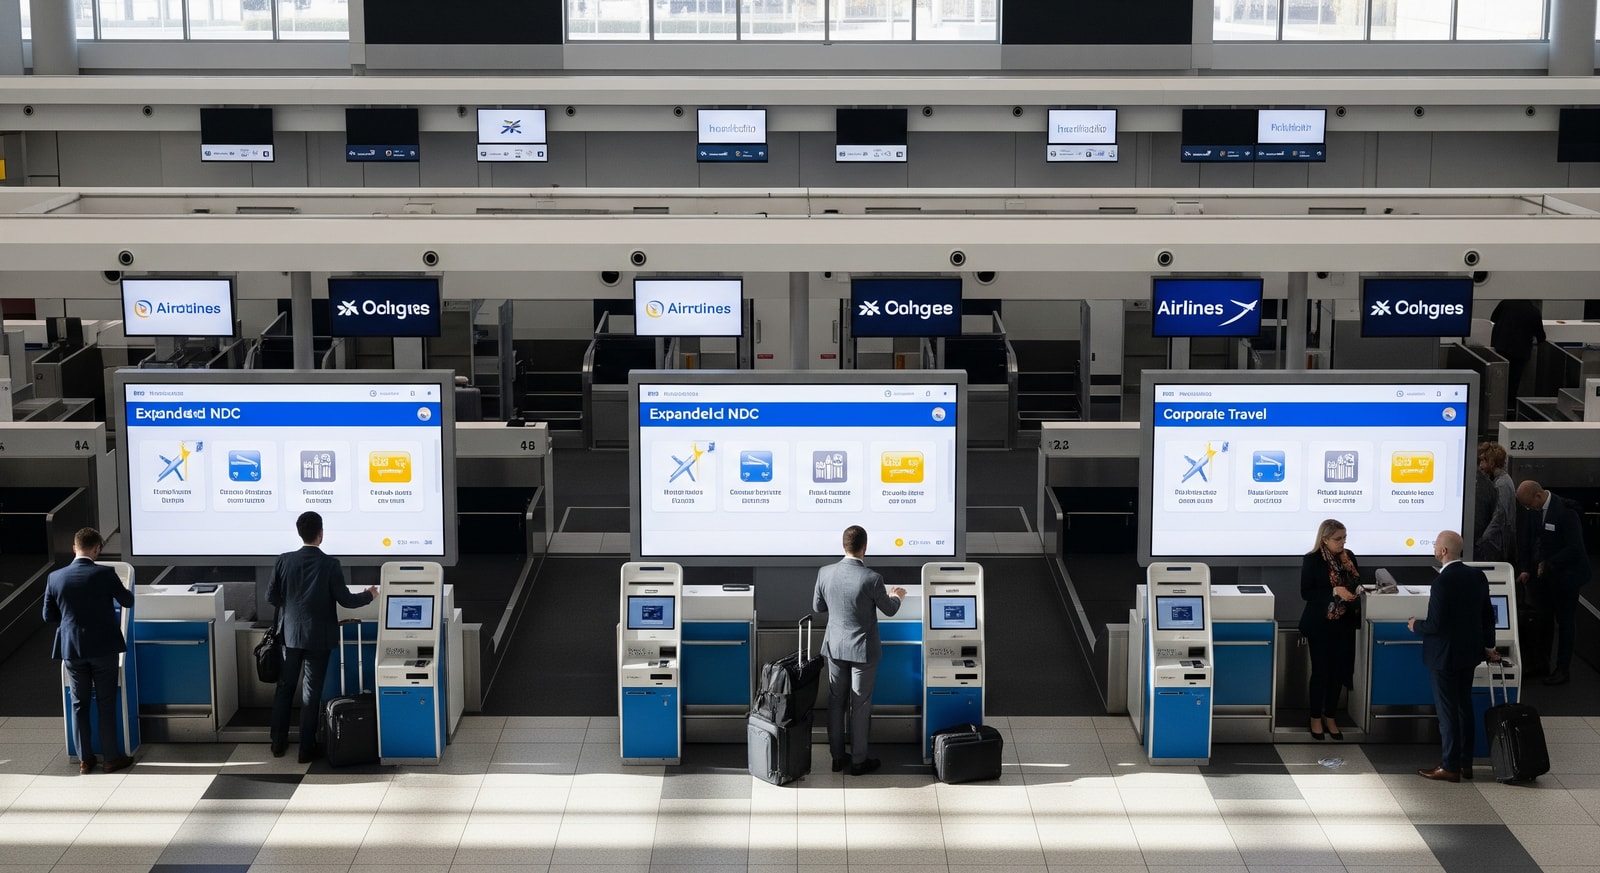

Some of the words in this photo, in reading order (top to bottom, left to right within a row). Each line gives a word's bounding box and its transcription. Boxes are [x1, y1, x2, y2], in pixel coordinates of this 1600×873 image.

[1157, 300, 1224, 315] Airlines
[210, 407, 241, 419] NDC
[728, 408, 760, 419] NDC
[1163, 408, 1225, 422] Corporate
[1228, 407, 1267, 420] Travel
